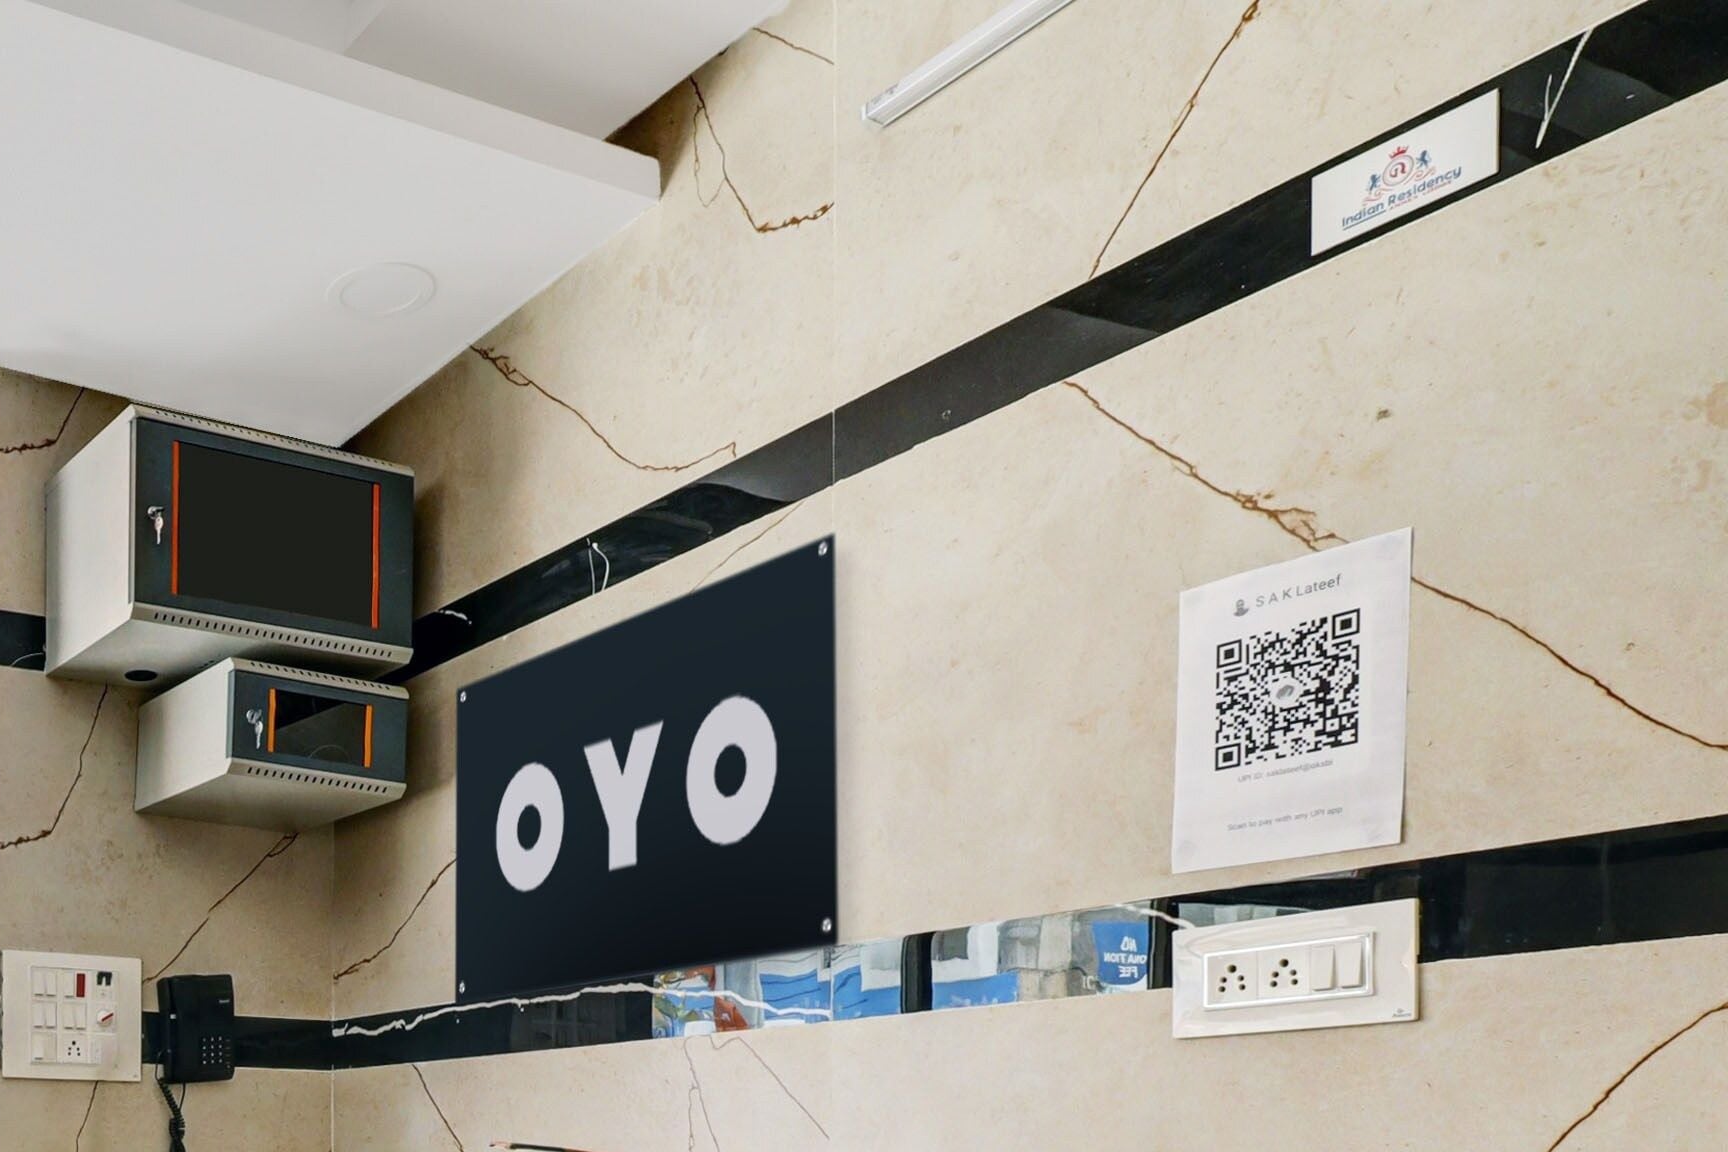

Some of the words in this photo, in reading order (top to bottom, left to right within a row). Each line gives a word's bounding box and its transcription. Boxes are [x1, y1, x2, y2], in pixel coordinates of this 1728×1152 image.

[1342, 202, 1384, 227] Indian
[1388, 166, 1462, 207] Residency
[1295, 572, 1342, 597] Lateef
[496, 694, 777, 892] OYO
